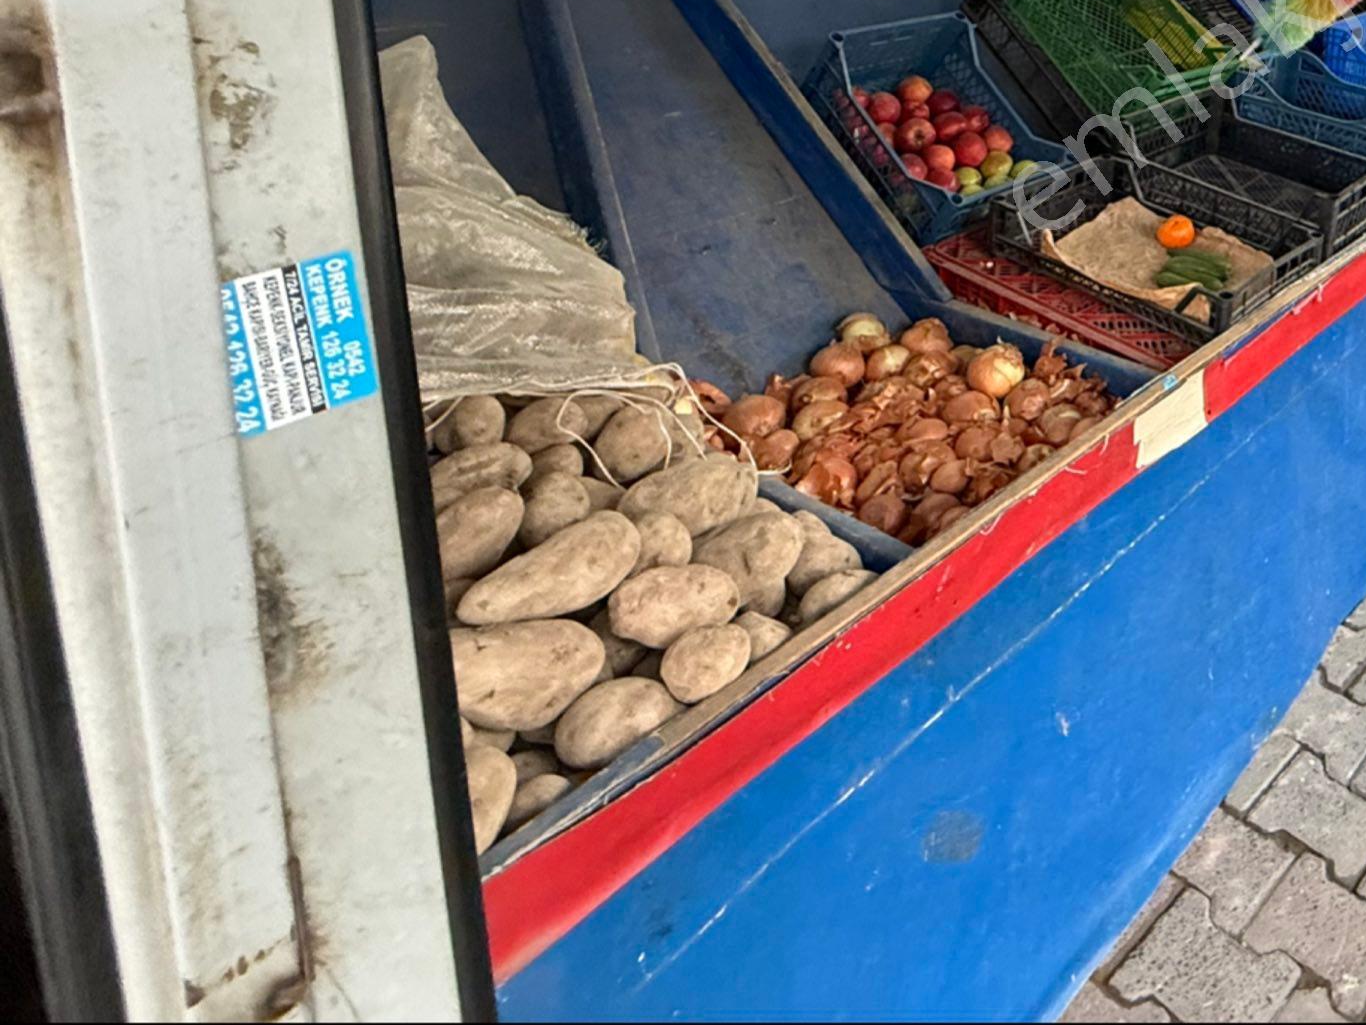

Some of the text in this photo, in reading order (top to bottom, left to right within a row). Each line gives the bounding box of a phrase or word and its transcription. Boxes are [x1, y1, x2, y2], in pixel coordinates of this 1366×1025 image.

[306, 265, 352, 400] KEPENK 126 32 24
[325, 257, 366, 376] ÖRNEK 0542
[236, 407, 261, 433] 24
